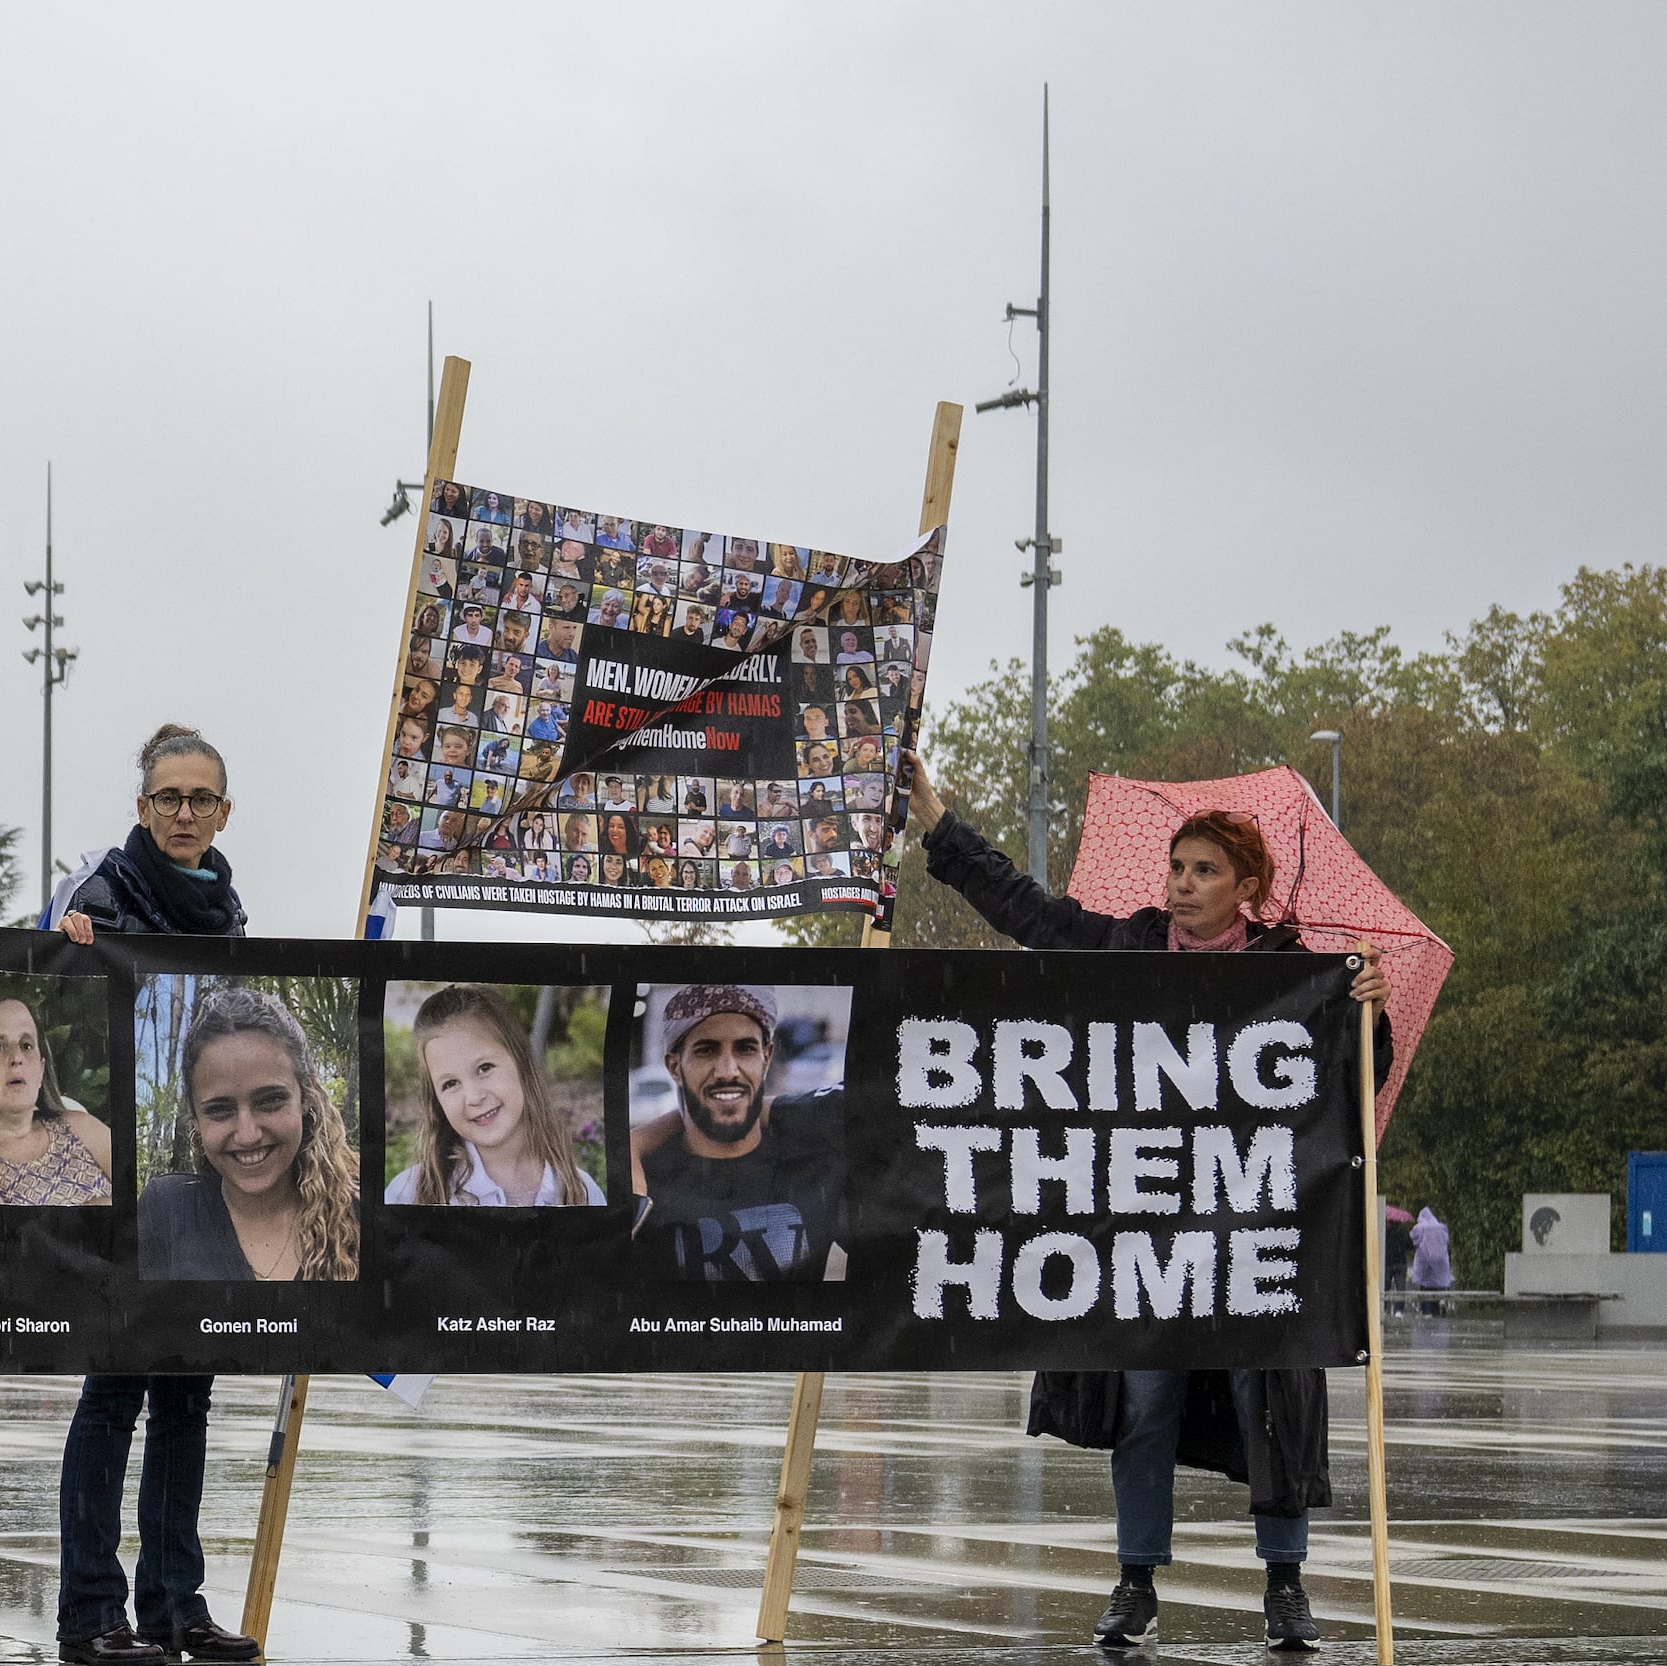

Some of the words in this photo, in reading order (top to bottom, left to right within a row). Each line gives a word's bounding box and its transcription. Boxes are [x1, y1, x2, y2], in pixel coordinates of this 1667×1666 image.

[586, 657, 631, 694] MEN.
[723, 654, 782, 683] DERLY.
[582, 699, 617, 728] ARE
[706, 691, 724, 715] BY
[727, 693, 781, 718] HAMAS
[617, 723, 741, 751] hemHomeNow
[422, 886, 434, 899] OF
[435, 885, 480, 901] CIVILIANS
[481, 886, 508, 902] WERE
[508, 888, 536, 904] TAKEN
[537, 889, 577, 906] HOSTAGE
[578, 891, 589, 906] BY
[590, 892, 622, 909] HAMAS
[623, 893, 633, 909] IN
[633, 894, 641, 910] A
[641, 894, 674, 912] BRUTAL
[675, 896, 711, 913] TERROR
[713, 897, 749, 913] ATTACK
[751, 896, 765, 911] ON
[767, 892, 803, 910] ISRAEL
[821, 886, 860, 900] HOSTAGES
[897, 1017, 1319, 1112] BRING
[914, 1121, 1299, 1215] THEM
[909, 1225, 1304, 1320] HOME
[15, 1317, 70, 1333] Sharon
[200, 1318, 253, 1333] Gonen
[257, 1318, 298, 1333] Romi
[437, 1317, 473, 1331] Katz
[476, 1317, 521, 1331] Asher
[525, 1317, 556, 1331] Raz
[630, 1317, 661, 1332] Abu
[665, 1317, 705, 1332] Amar
[709, 1317, 764, 1332] Suhaib
[768, 1317, 843, 1332] Muhamad
